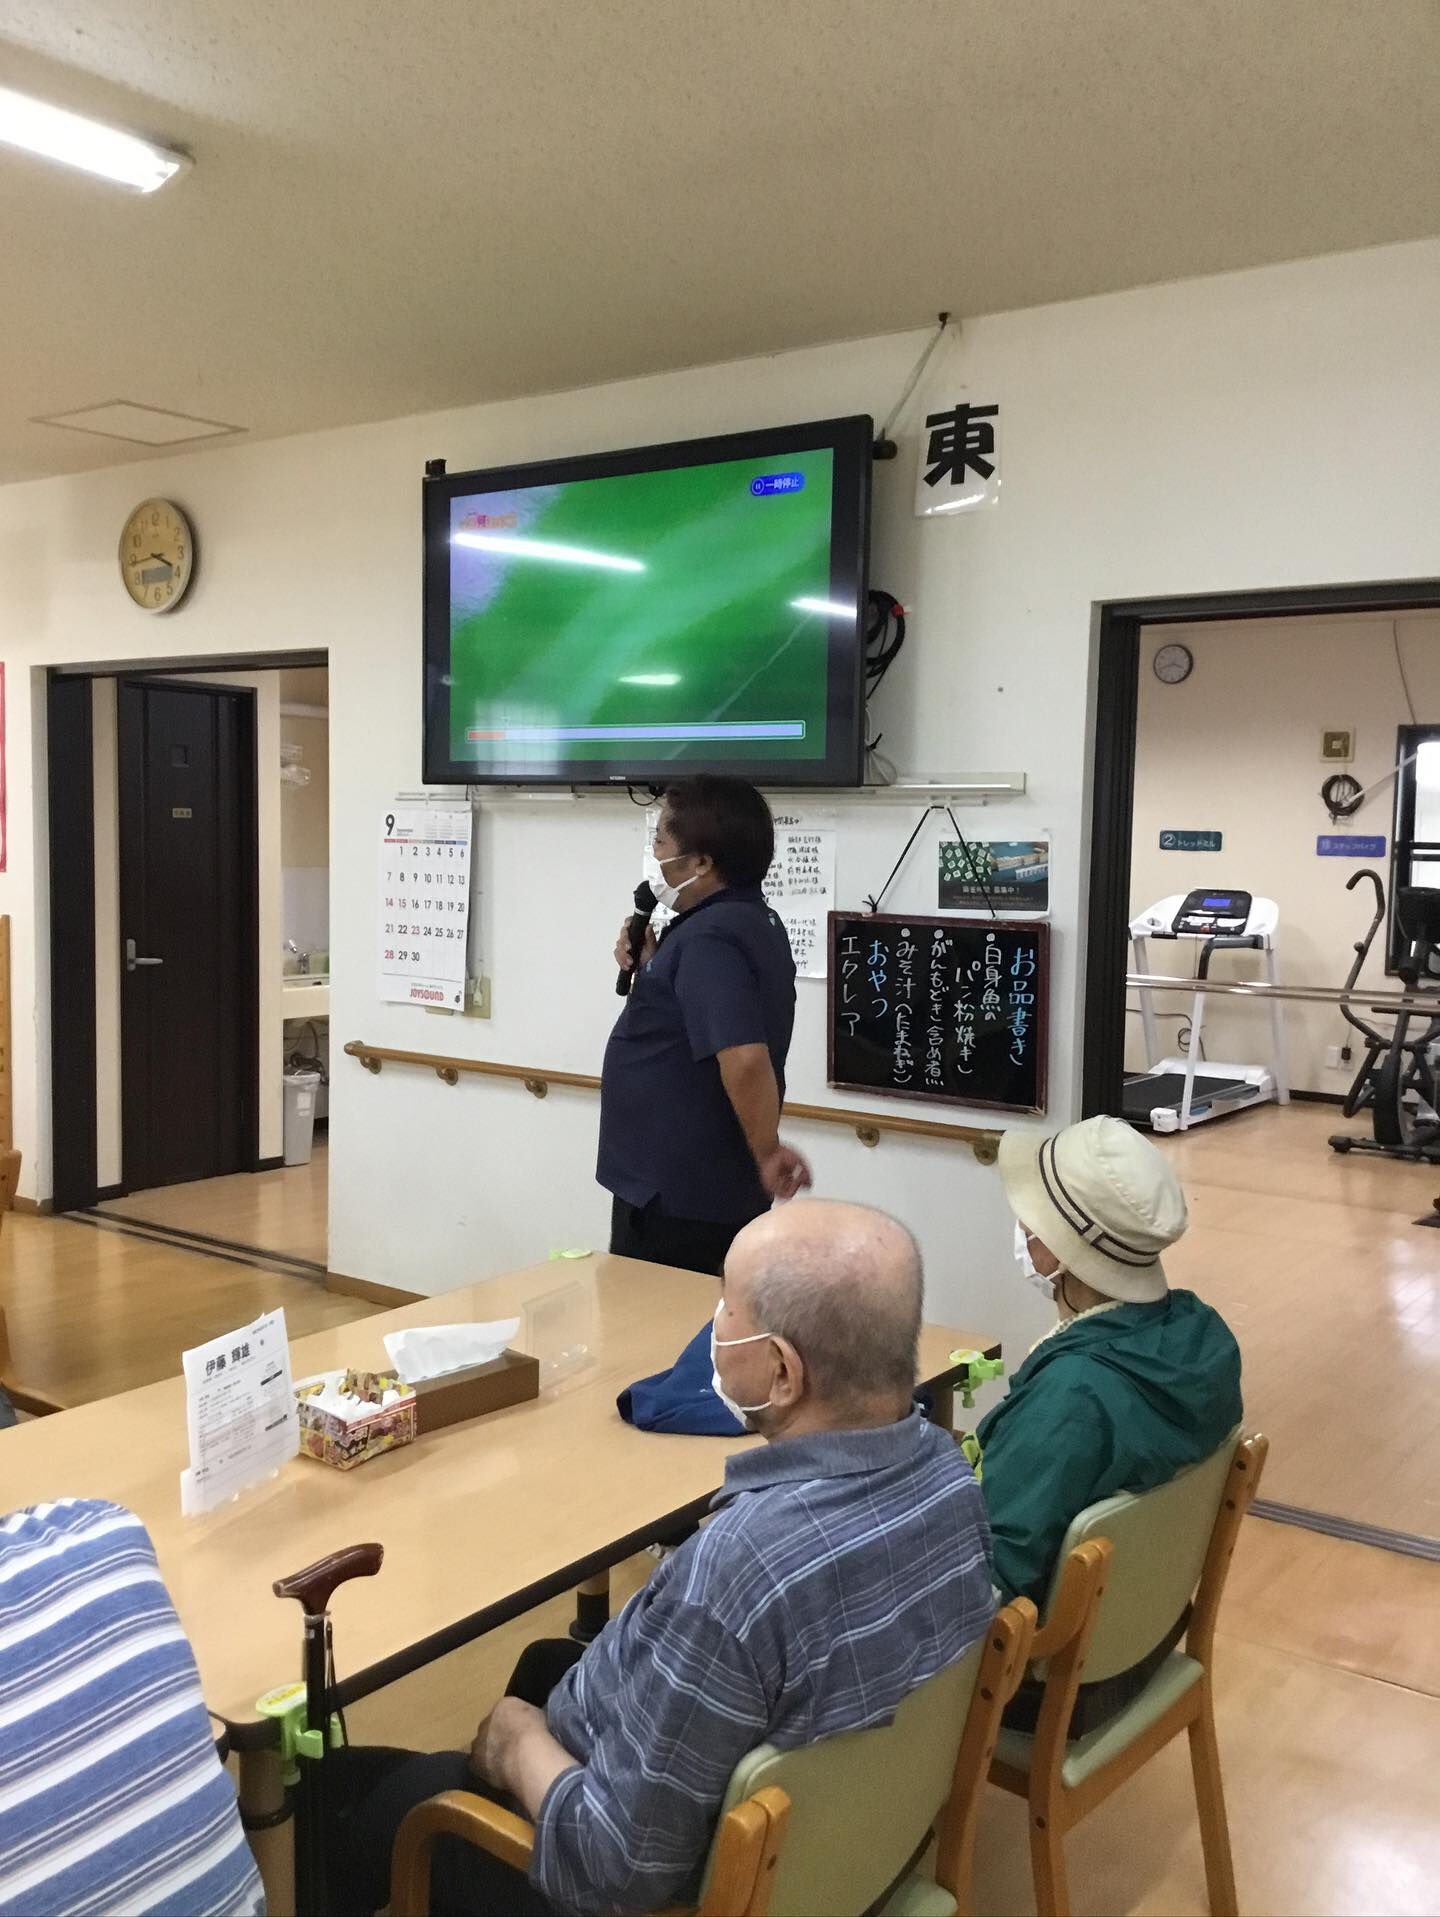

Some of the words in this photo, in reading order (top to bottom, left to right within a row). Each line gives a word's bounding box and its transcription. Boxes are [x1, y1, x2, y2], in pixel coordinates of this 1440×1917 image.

[923, 403, 999, 488] 東
[385, 814, 395, 836] 9
[400, 846, 403, 856] 1
[413, 846, 418, 856] 2
[426, 847, 430, 856] 3
[437, 847, 441, 856] 4
[449, 848, 454, 857] 5
[460, 849, 464, 858] 6
[387, 872, 392, 881] 7
[400, 872, 404, 882] 8
[413, 872, 418, 883] 9
[424, 873, 432, 883] 10
[436, 874, 442, 883] 11
[448, 874, 454, 885] 12
[458, 875, 465, 885] 13
[385, 898, 393, 907] 14
[399, 898, 406, 908] 15
[412, 899, 419, 909] 16
[424, 900, 431, 909] 17
[436, 901, 442, 911] 18
[447, 902, 454, 911] 19
[457, 902, 464, 912] 20
[384, 950, 394, 959] 28
[398, 951, 408, 960] 29
[411, 952, 420, 961] 30
[385, 924, 393, 933] 21
[398, 925, 407, 934] 22
[411, 925, 420, 935] 23
[423, 926, 432, 936] 24
[435, 927, 443, 937] 25
[446, 928, 454, 938] 26
[457, 929, 464, 939] 27
[410, 988, 444, 1001] JOYSOUND
[840, 936, 861, 1036] エクレア
[867, 939, 890, 1018] おやつ
[980, 943, 1002, 1020] 白身魚の
[924, 939, 953, 1086] がんもどき含め煮
[954, 960, 982, 1074] パン粉焼き
[1006, 947, 1035, 1066] お品書き
